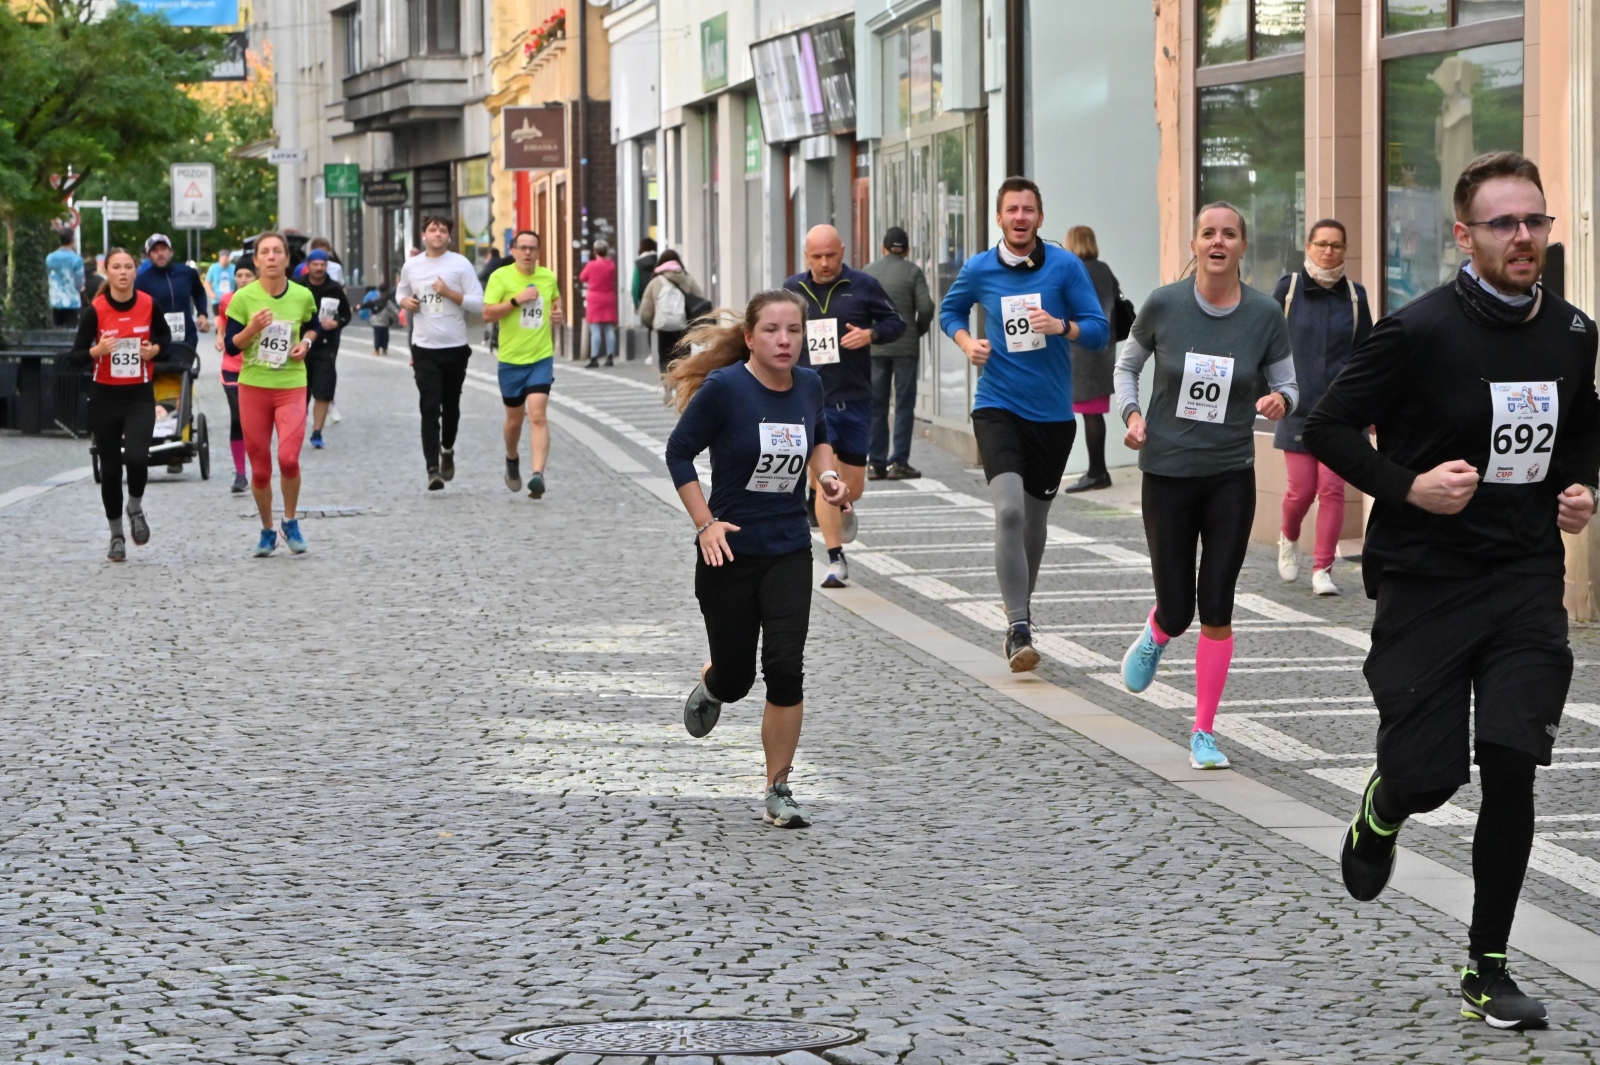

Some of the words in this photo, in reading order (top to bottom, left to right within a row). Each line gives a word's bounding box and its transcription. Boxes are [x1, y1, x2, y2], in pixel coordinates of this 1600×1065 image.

[176, 168, 209, 178] POZOR
[420, 293, 442, 304] 478
[521, 308, 542, 319] 149
[1005, 317, 1036, 336] 69
[260, 336, 288, 352] 463
[809, 336, 835, 352] 241
[111, 353, 140, 366] 635
[1189, 380, 1221, 402] 60
[1493, 423, 1554, 455] 692
[755, 453, 804, 475] 370
